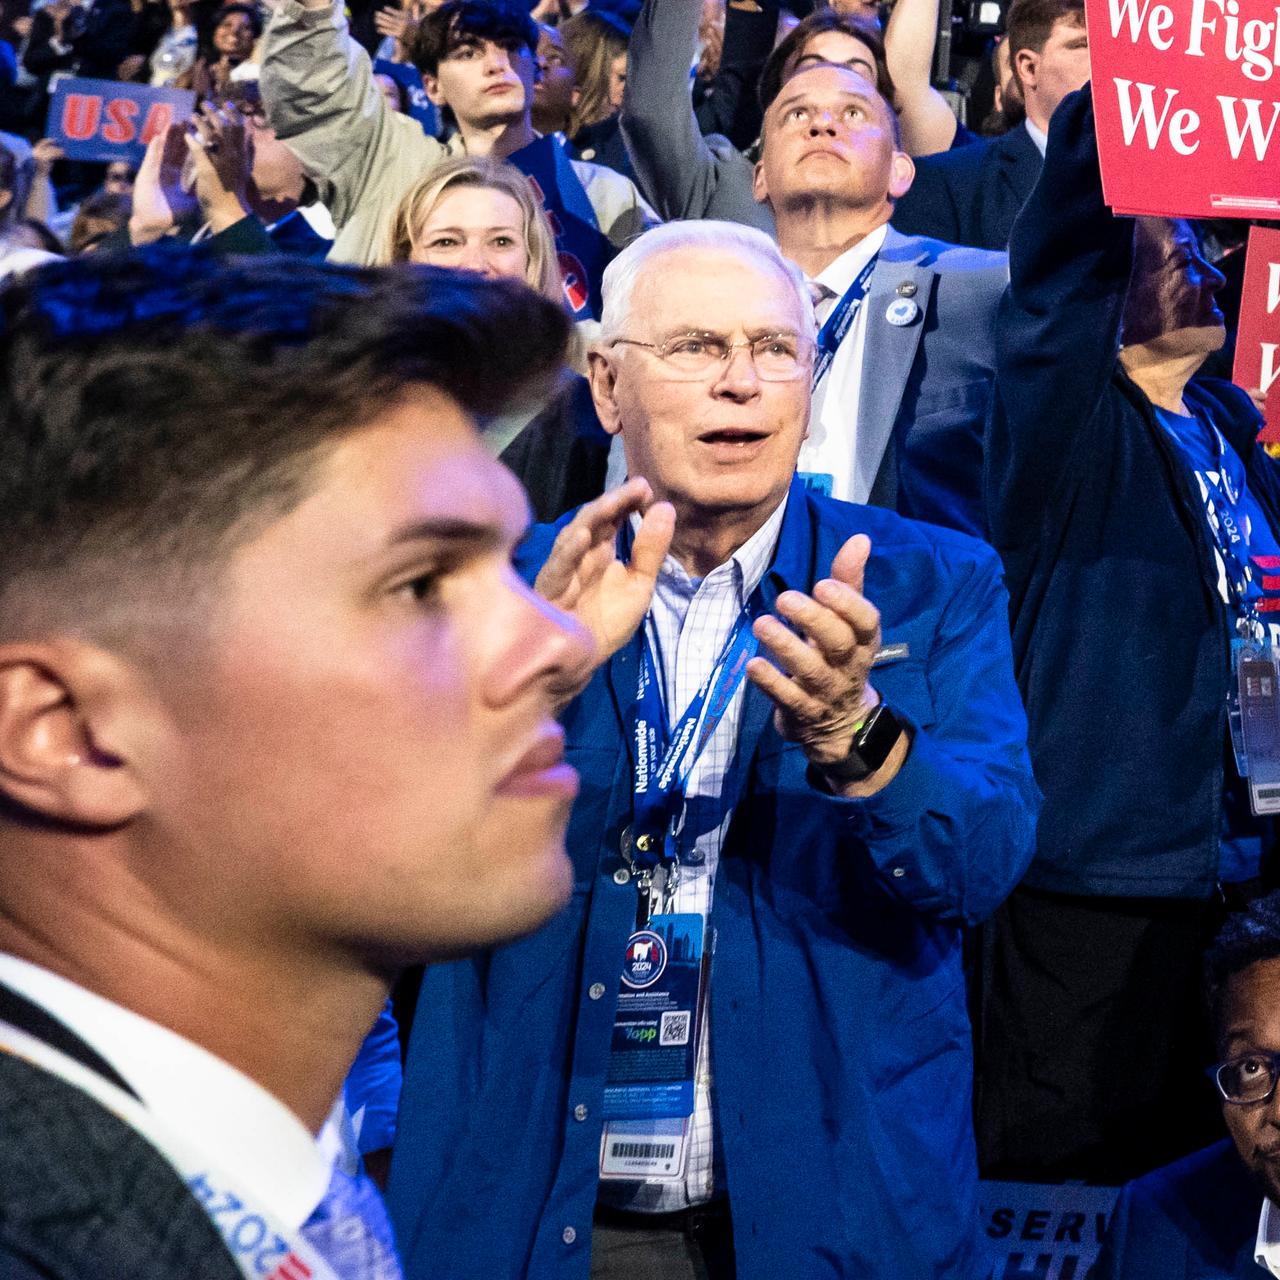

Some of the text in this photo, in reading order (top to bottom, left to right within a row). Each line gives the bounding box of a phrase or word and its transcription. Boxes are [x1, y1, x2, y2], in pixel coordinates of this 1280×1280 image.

[61, 91, 177, 145] USA
[1112, 76, 1201, 156] We
[635, 719, 648, 794] Nationwide
